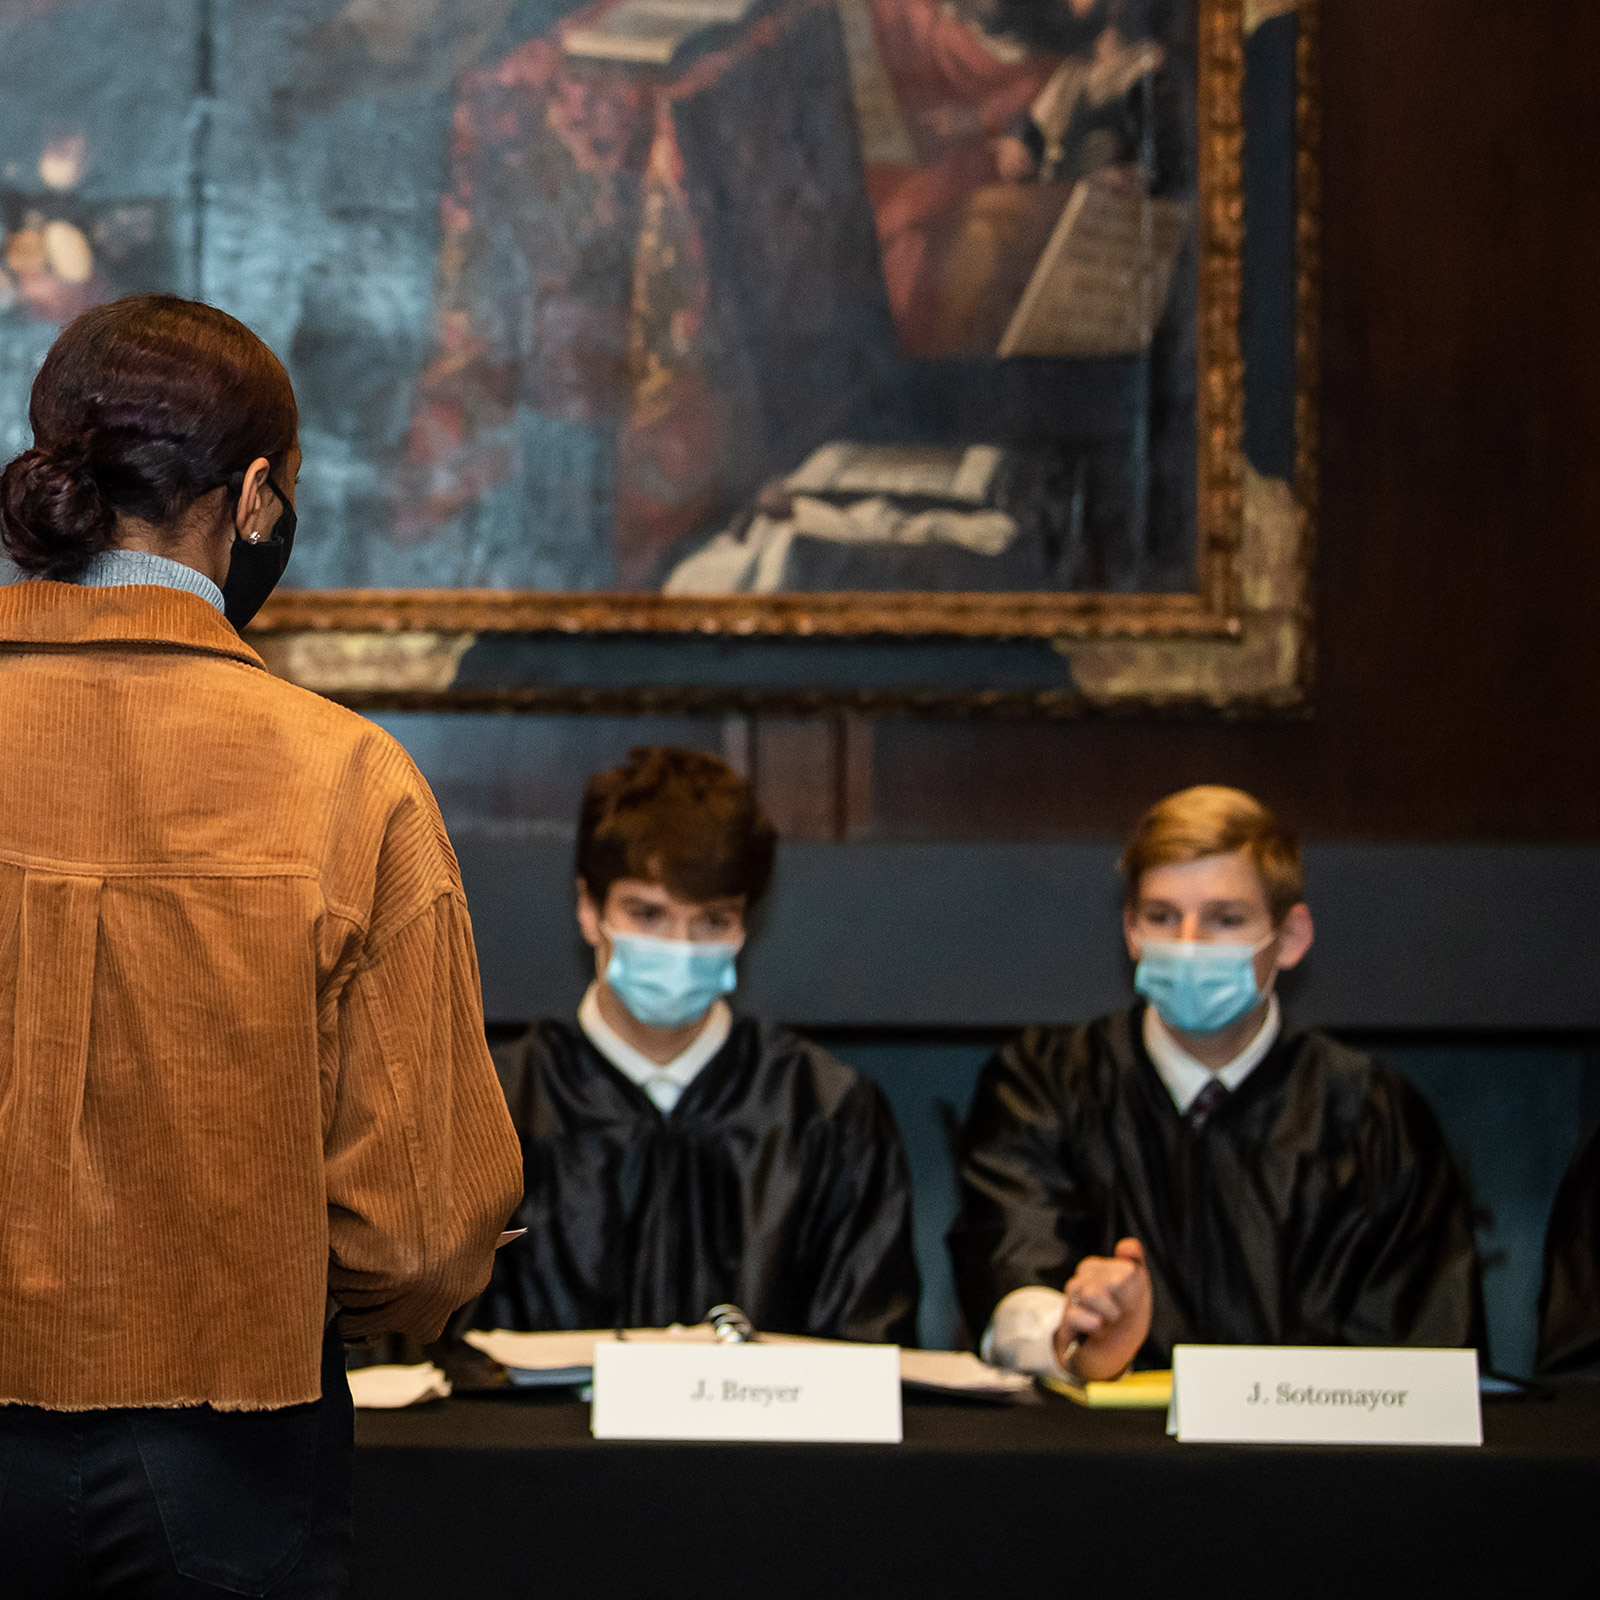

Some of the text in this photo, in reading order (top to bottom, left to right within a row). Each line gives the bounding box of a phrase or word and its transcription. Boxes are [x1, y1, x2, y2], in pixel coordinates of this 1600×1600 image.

[690, 1378, 802, 1408] J. Breyer
[1247, 1381, 1409, 1412] J. Sotomayor
